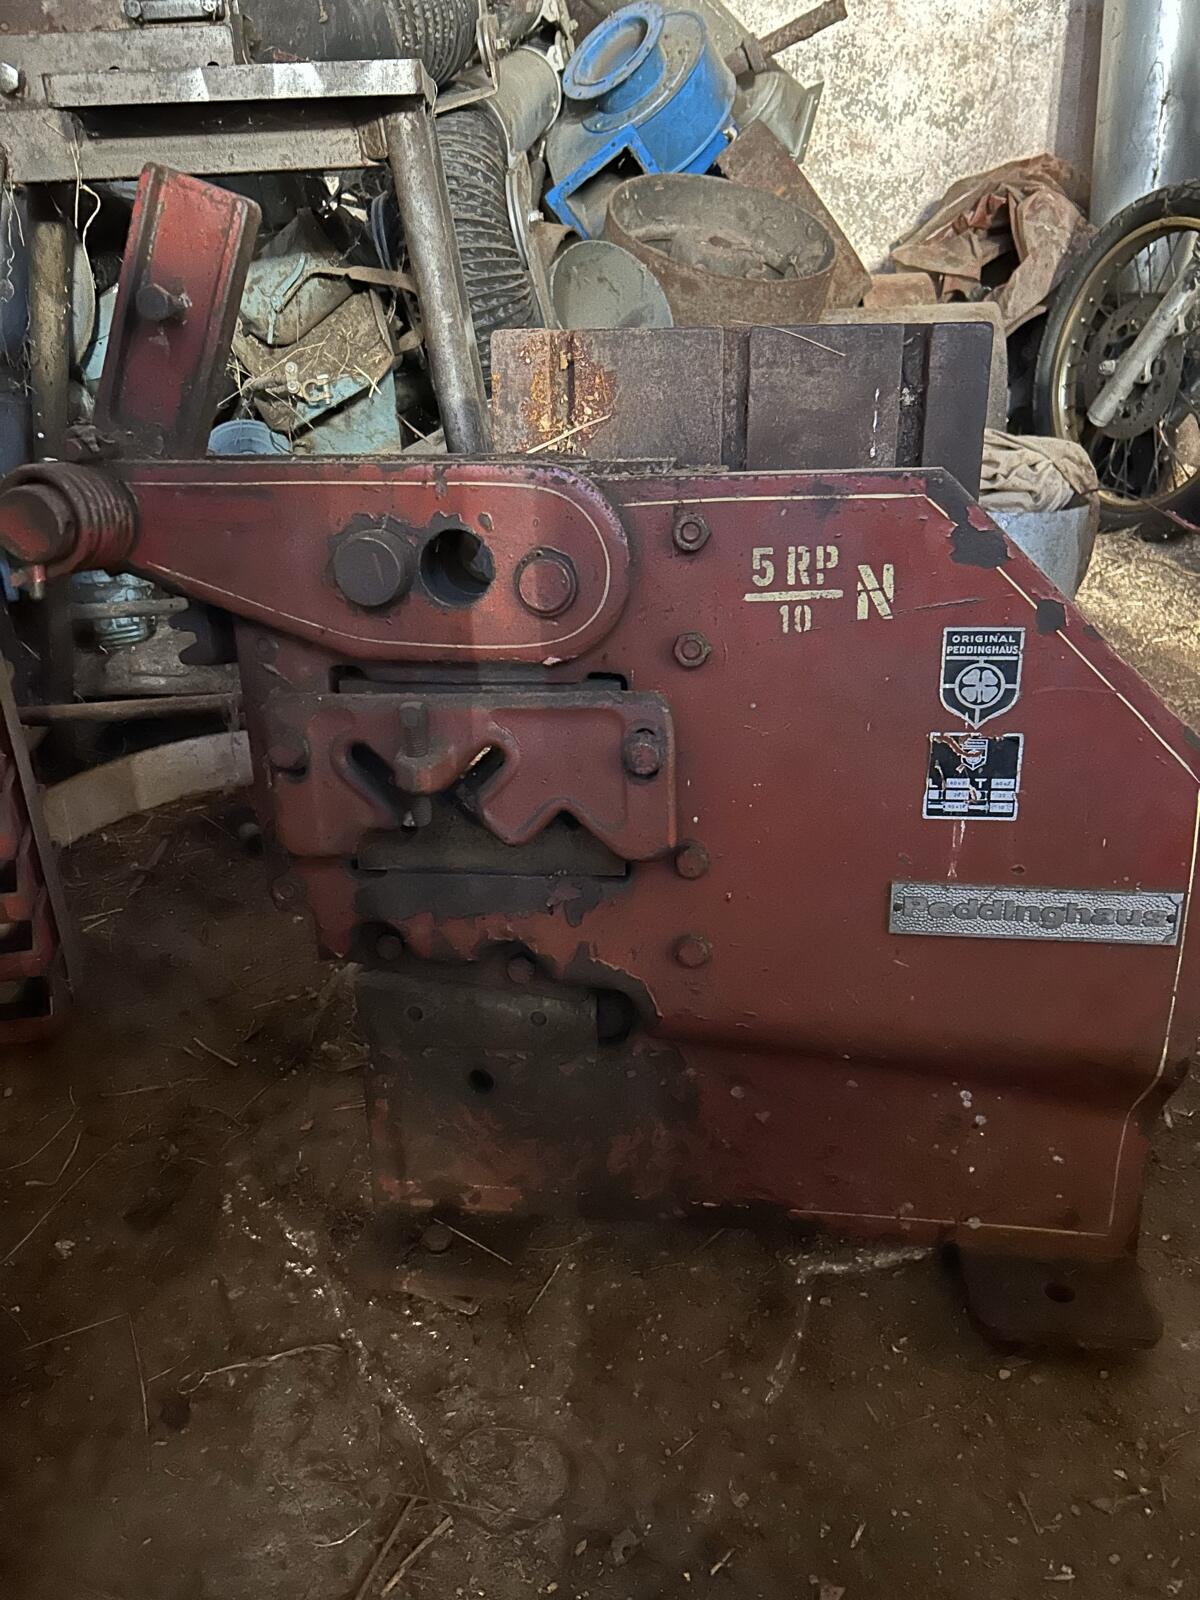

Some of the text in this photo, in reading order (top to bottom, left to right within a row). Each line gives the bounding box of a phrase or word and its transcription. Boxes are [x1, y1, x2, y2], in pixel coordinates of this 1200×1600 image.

[751, 545, 840, 587] 5 RP
[856, 563, 895, 620] N
[778, 604, 812, 634] 10
[946, 645, 1019, 655] PEDDINGHAUS
[952, 634, 1016, 644] ORIGINAL
[902, 895, 1168, 930] Peddinghaus
